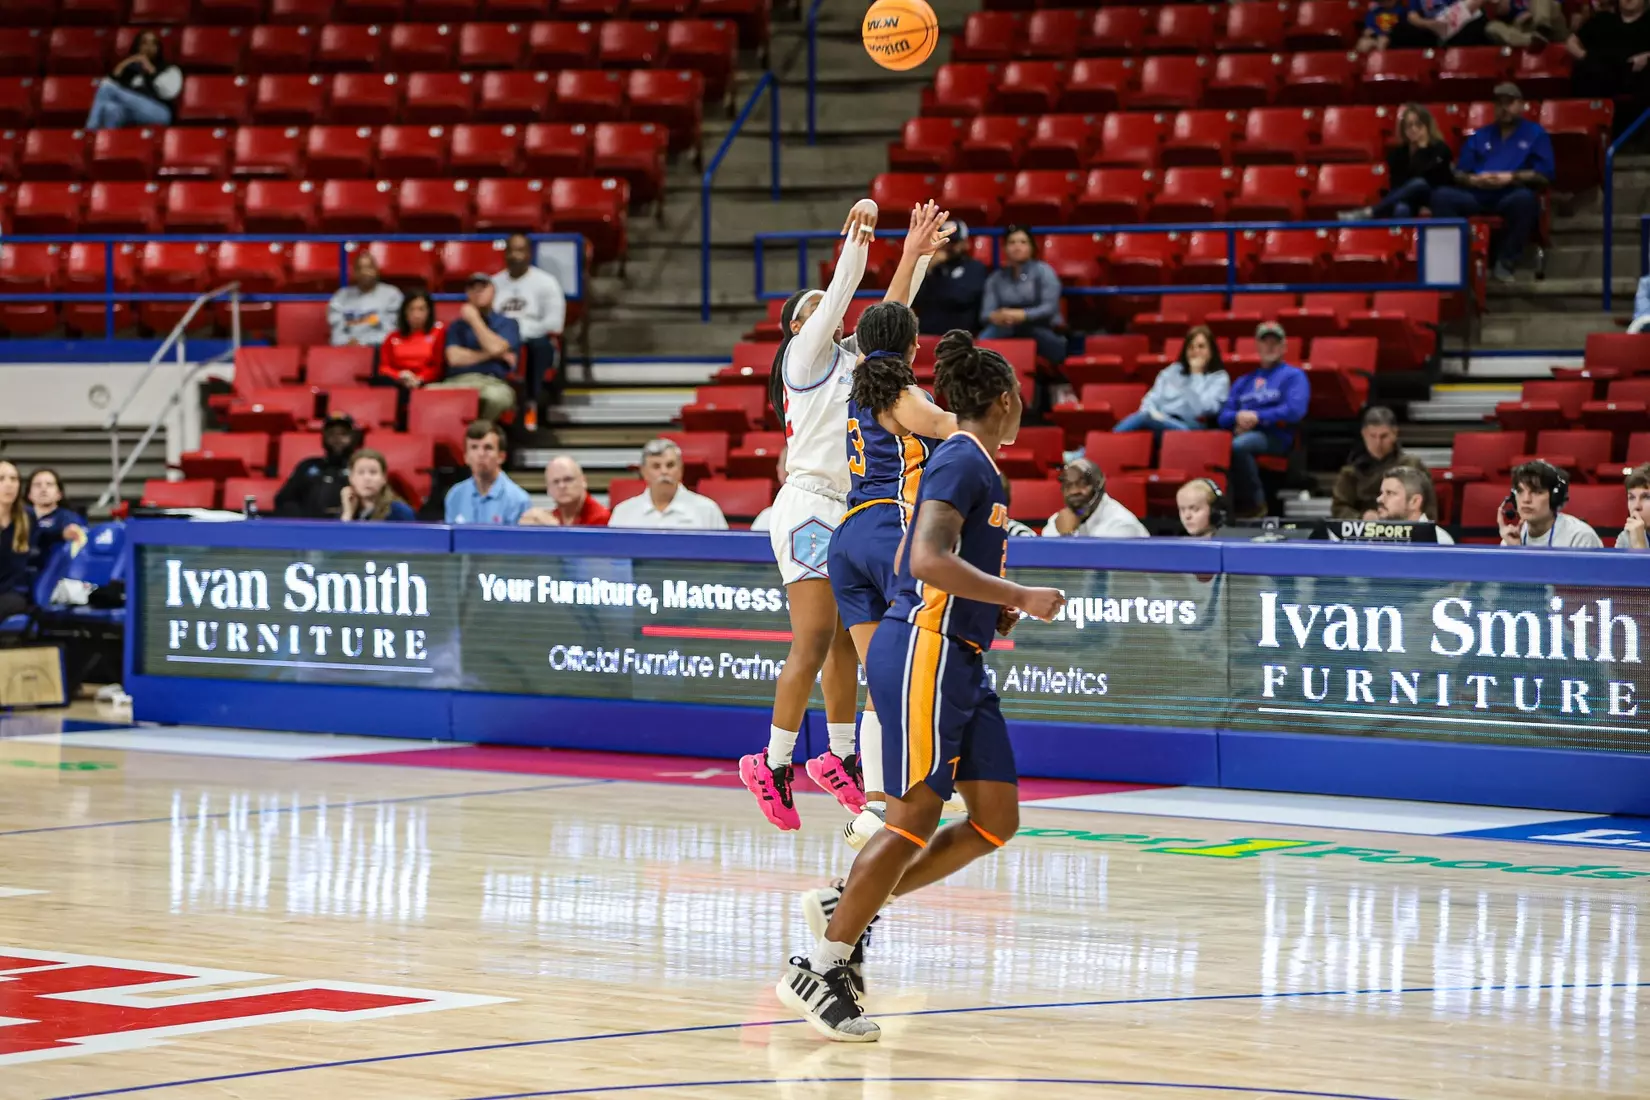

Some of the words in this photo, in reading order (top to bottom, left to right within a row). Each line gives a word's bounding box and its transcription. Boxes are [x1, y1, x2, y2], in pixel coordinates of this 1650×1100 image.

[166, 559, 270, 610] Ivan
[284, 561, 430, 616] Smith
[478, 573, 534, 603] Your
[537, 575, 659, 614] Furniture,
[662, 579, 783, 612] Mattress
[169, 620, 428, 660] FURNITURE
[1257, 590, 1407, 653] Ivan
[1431, 596, 1642, 663] Smith
[549, 644, 620, 673] Official
[622, 647, 714, 678] Furniture
[1003, 663, 1109, 695] Athletics
[1261, 663, 1639, 717] FURNITURE
[1278, 846, 1650, 880] Foods
